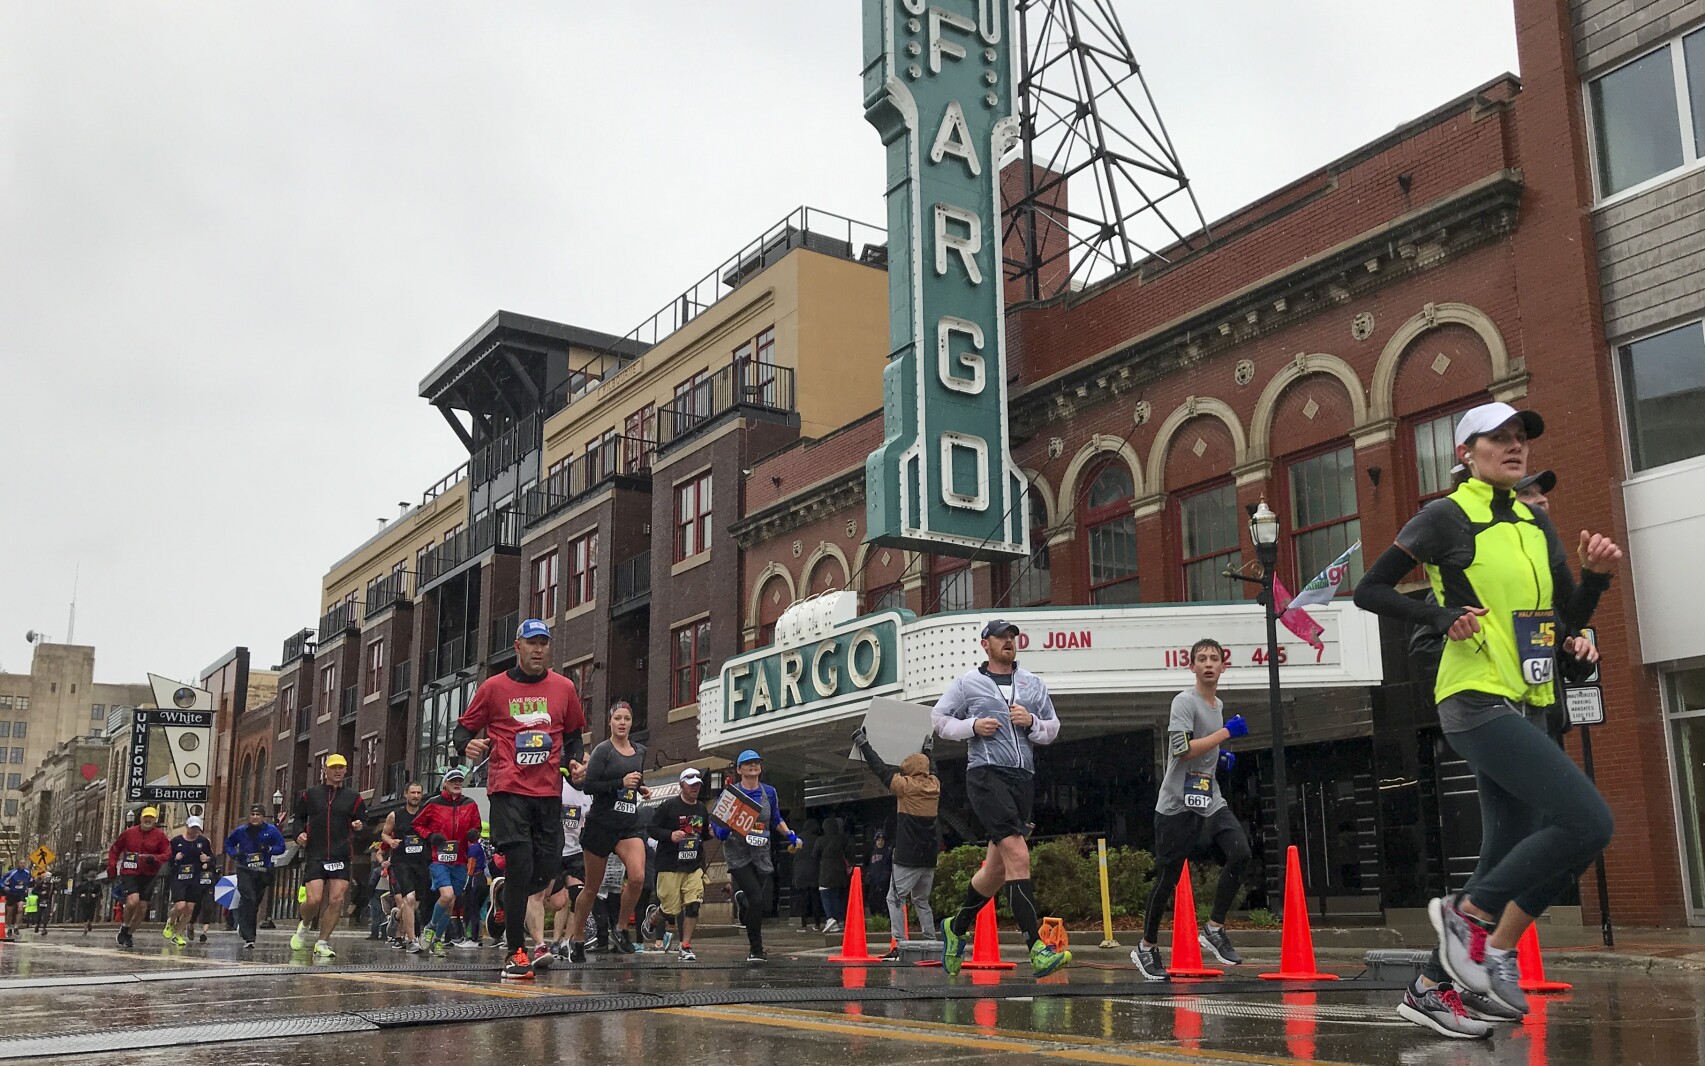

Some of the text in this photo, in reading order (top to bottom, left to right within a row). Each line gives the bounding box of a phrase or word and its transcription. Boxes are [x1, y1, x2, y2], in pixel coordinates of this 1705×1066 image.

[929, 5, 990, 511] FARGO
[1043, 631, 1092, 649] JOAN
[728, 628, 881, 721] FARGO
[160, 711, 203, 724] White
[130, 713, 147, 798] UNIFORMS
[520, 752, 548, 764] 2773
[150, 788, 202, 799] Banner
[616, 802, 635, 813] 2615
[715, 795, 735, 819] GOAL
[440, 854, 456, 862] 4053
